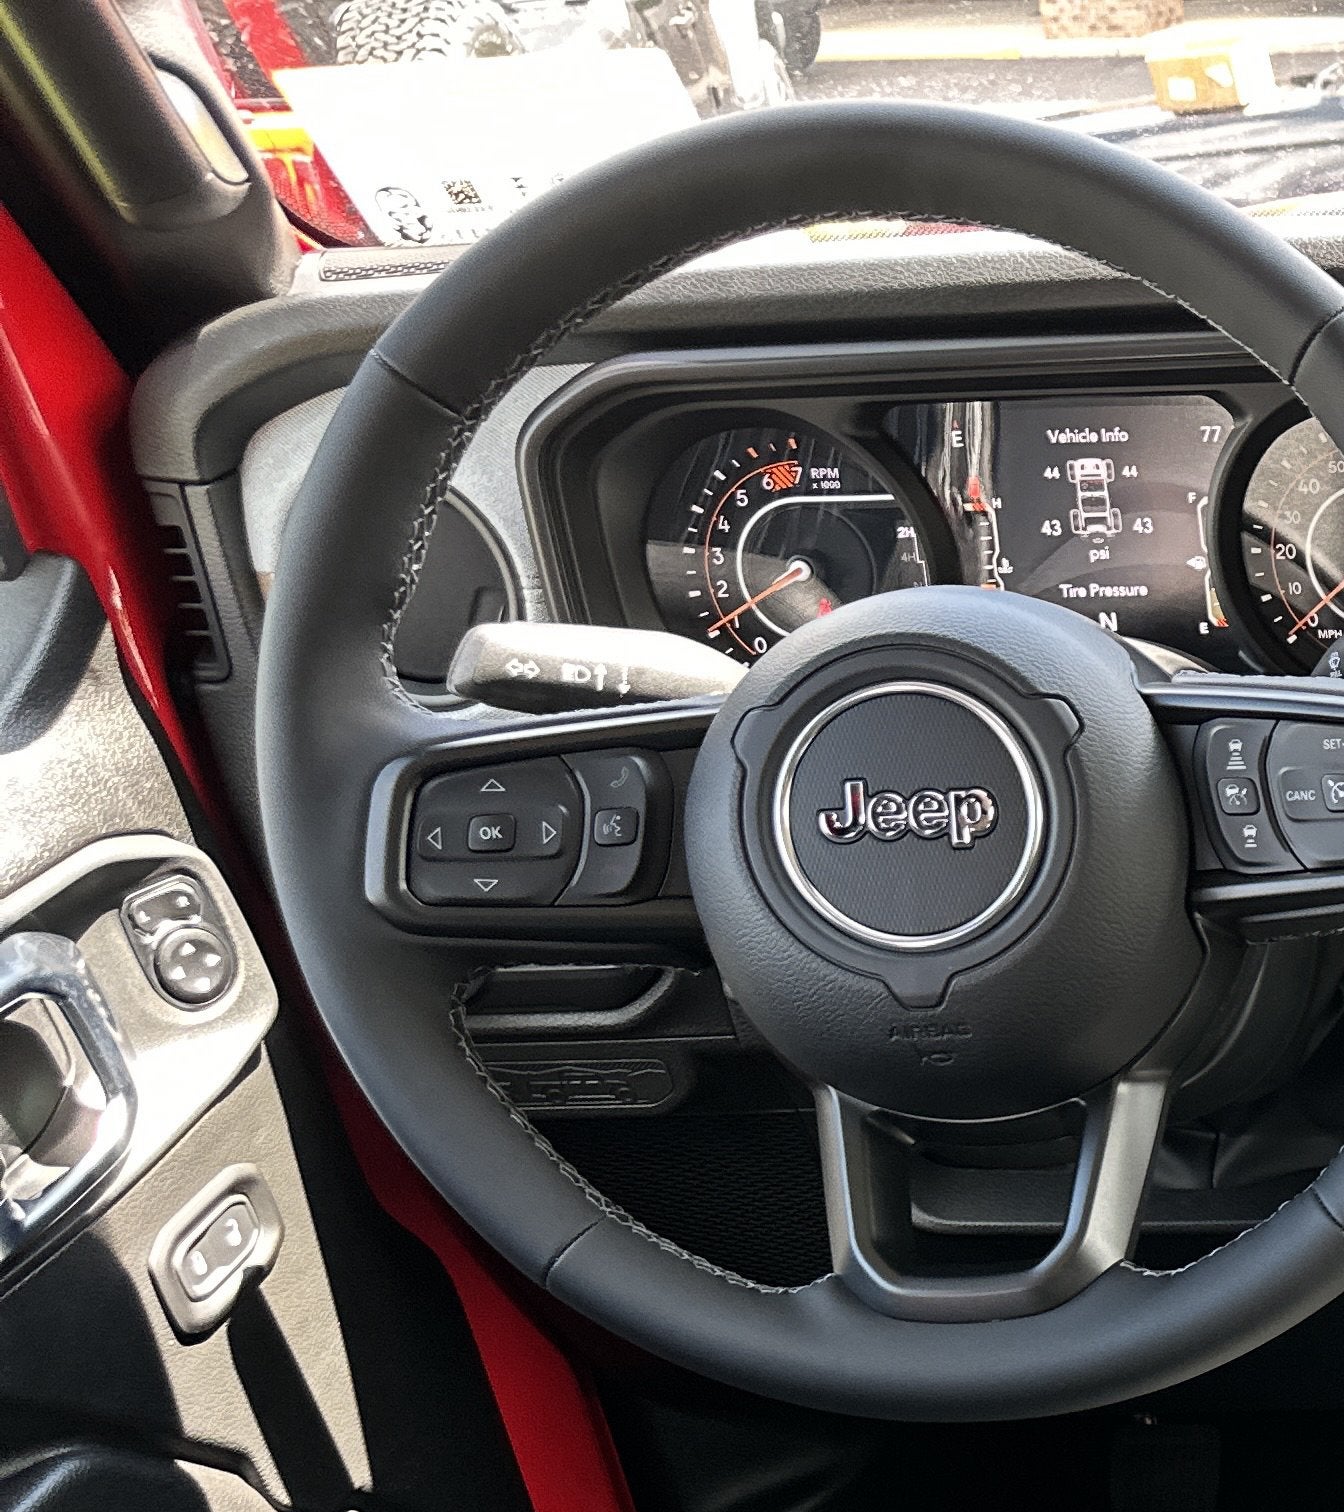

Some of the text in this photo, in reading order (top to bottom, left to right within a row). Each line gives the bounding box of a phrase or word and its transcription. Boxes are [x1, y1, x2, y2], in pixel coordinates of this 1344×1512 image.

[1046, 426, 1129, 445] Vehicle Info
[1200, 425, 1222, 443] 77
[810, 467, 840, 480] RPM
[1043, 466, 1061, 480] 44
[1121, 465, 1139, 479] 44
[762, 473, 773, 490] 6
[1299, 478, 1321, 495] 40
[736, 489, 749, 507] 5
[717, 516, 731, 533] 4
[896, 526, 916, 539] 2H
[1040, 519, 1062, 537] 43
[1132, 516, 1154, 535] 43
[712, 548, 725, 565] 3
[1089, 545, 1110, 563] psi
[1275, 543, 1297, 561] 20
[717, 581, 729, 598] 2
[1059, 583, 1149, 599] Tire Pressure
[1288, 581, 1302, 596] 10
[1099, 612, 1118, 632] N
[1317, 629, 1343, 640] MPH
[753, 636, 768, 655] 0
[1286, 790, 1316, 802] CANC
[817, 777, 1000, 850] Jeep
[479, 826, 503, 841] OK
